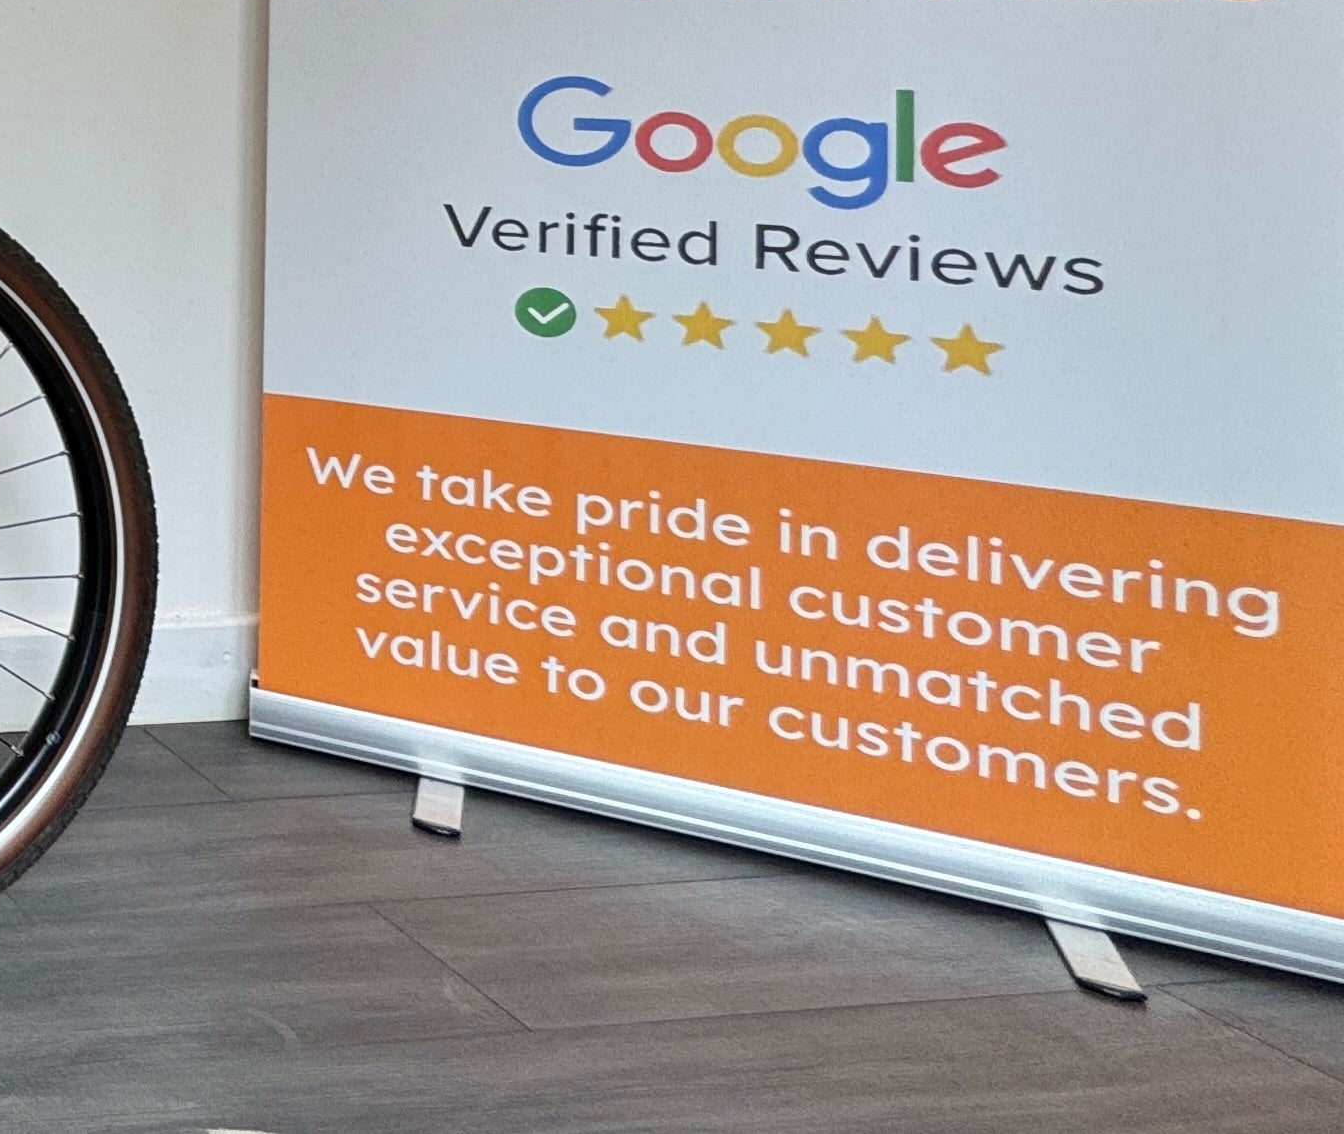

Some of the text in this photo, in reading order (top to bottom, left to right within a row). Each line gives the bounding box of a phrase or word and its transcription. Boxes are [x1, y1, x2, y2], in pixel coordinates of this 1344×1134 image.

[517, 75, 1006, 211] Google
[443, 203, 1104, 296] Verified Reviews
[307, 447, 1280, 639] We take pride in delivering
[385, 523, 1161, 674] exceptional customer
[356, 570, 1202, 751] service and unmatched
[356, 628, 1201, 820] value to our customers.
